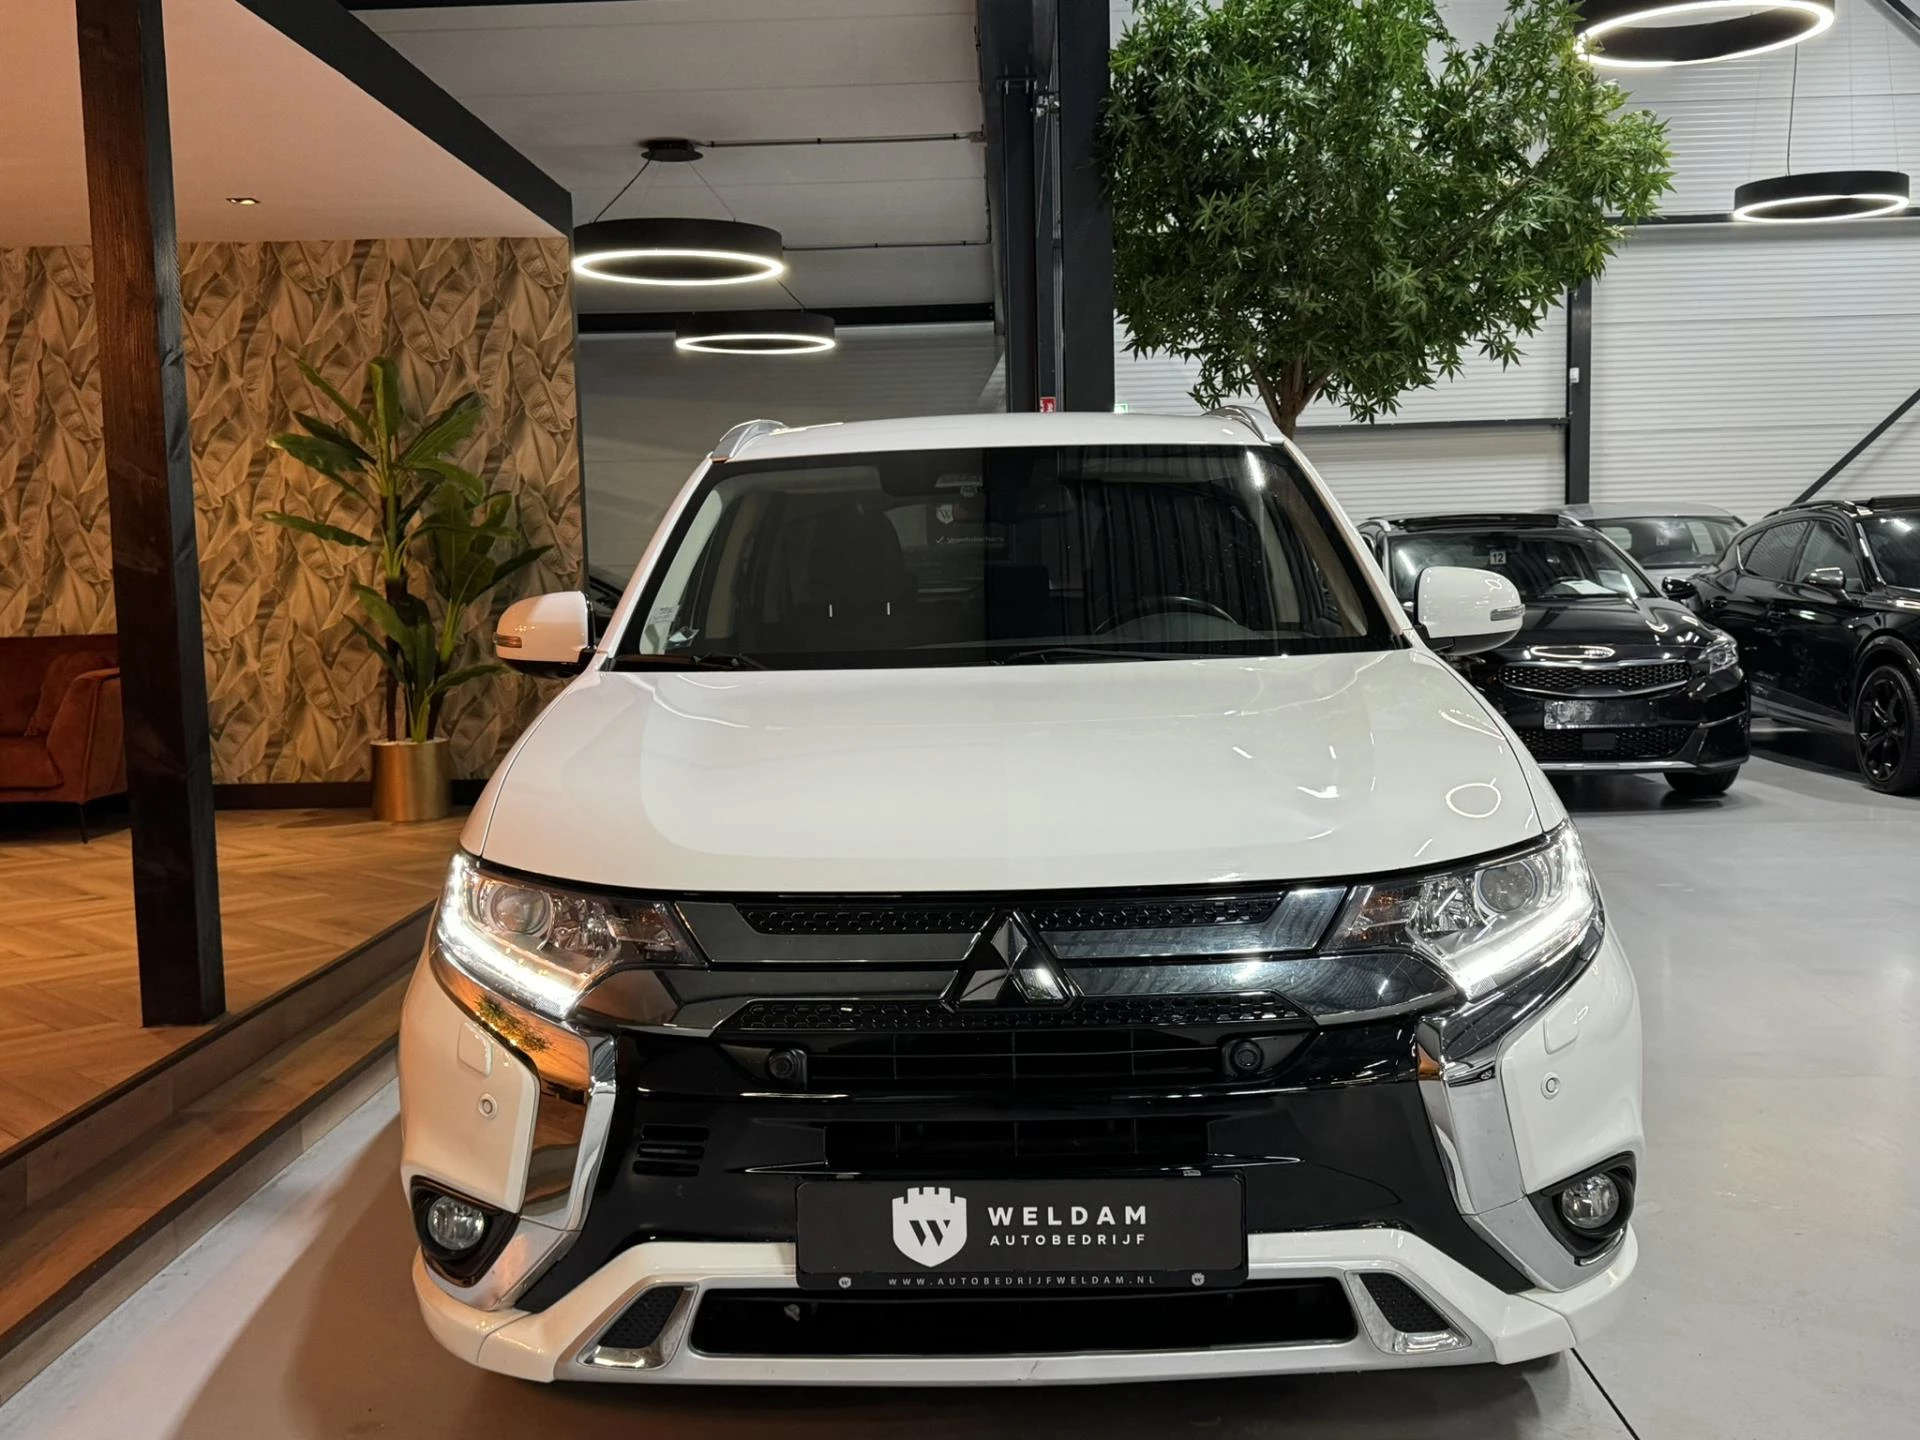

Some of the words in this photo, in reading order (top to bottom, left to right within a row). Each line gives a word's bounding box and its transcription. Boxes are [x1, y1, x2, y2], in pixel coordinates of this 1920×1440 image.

[1492, 552, 1504, 563] 12
[987, 1205, 1147, 1226] WELDAM
[988, 1233, 1146, 1247] AUTOBEDRIJF
[888, 1275, 1155, 1287] WWW.AUTOBEDRIJFWELDAM.NL
